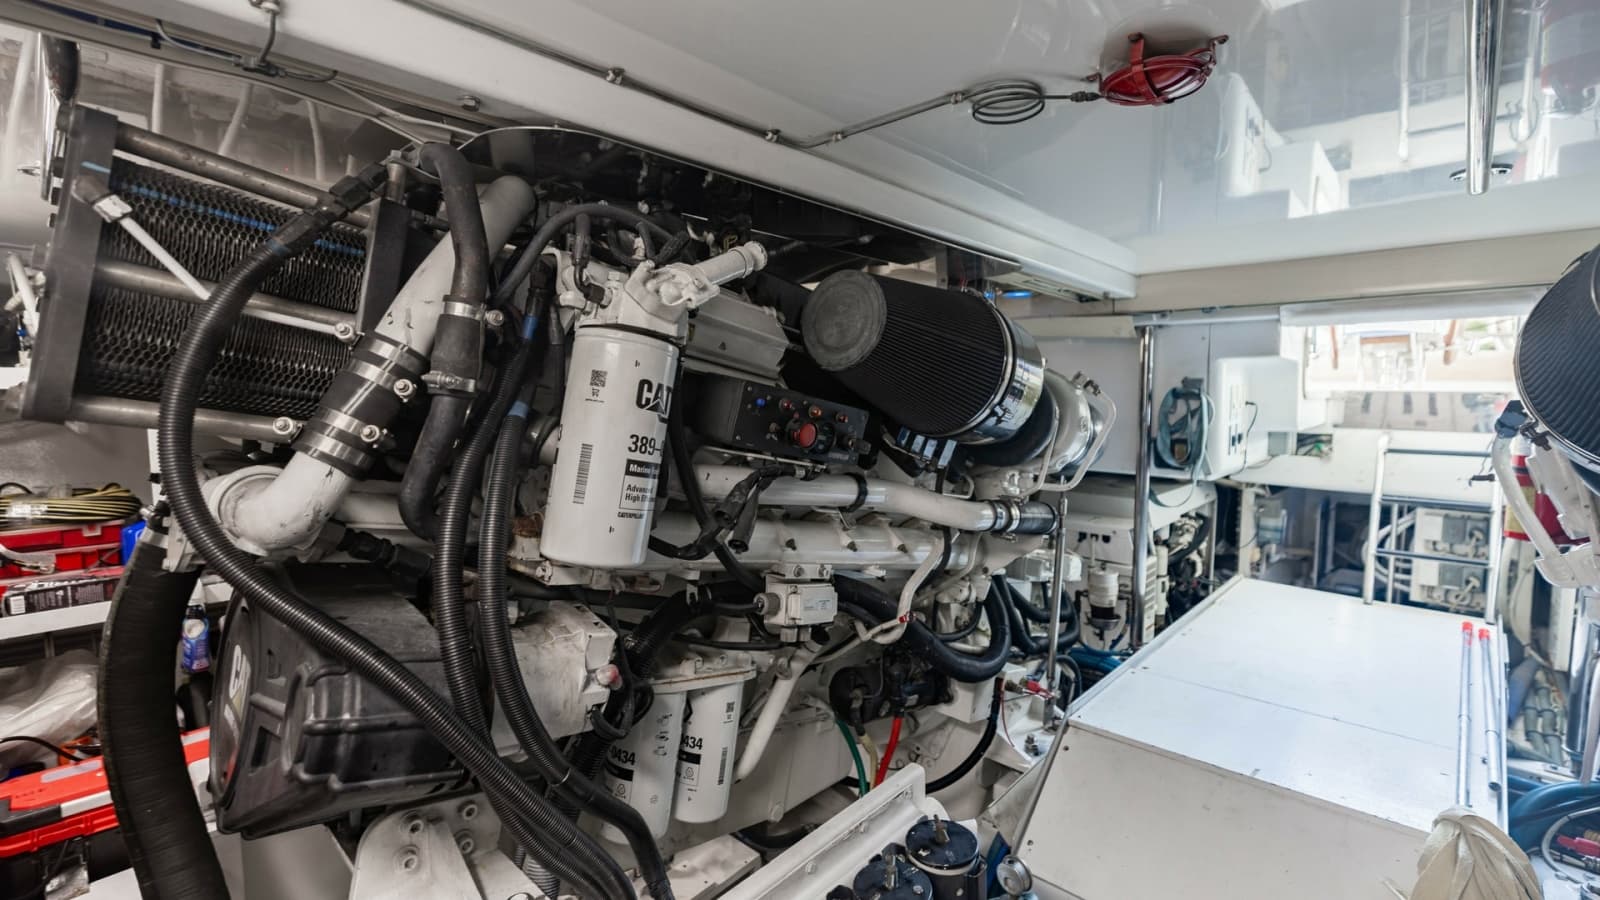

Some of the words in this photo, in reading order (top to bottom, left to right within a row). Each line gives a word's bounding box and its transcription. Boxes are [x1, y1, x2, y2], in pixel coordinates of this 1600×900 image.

[636, 379, 673, 413] CAT
[628, 434, 664, 456] 389-
[625, 493, 640, 503] High
